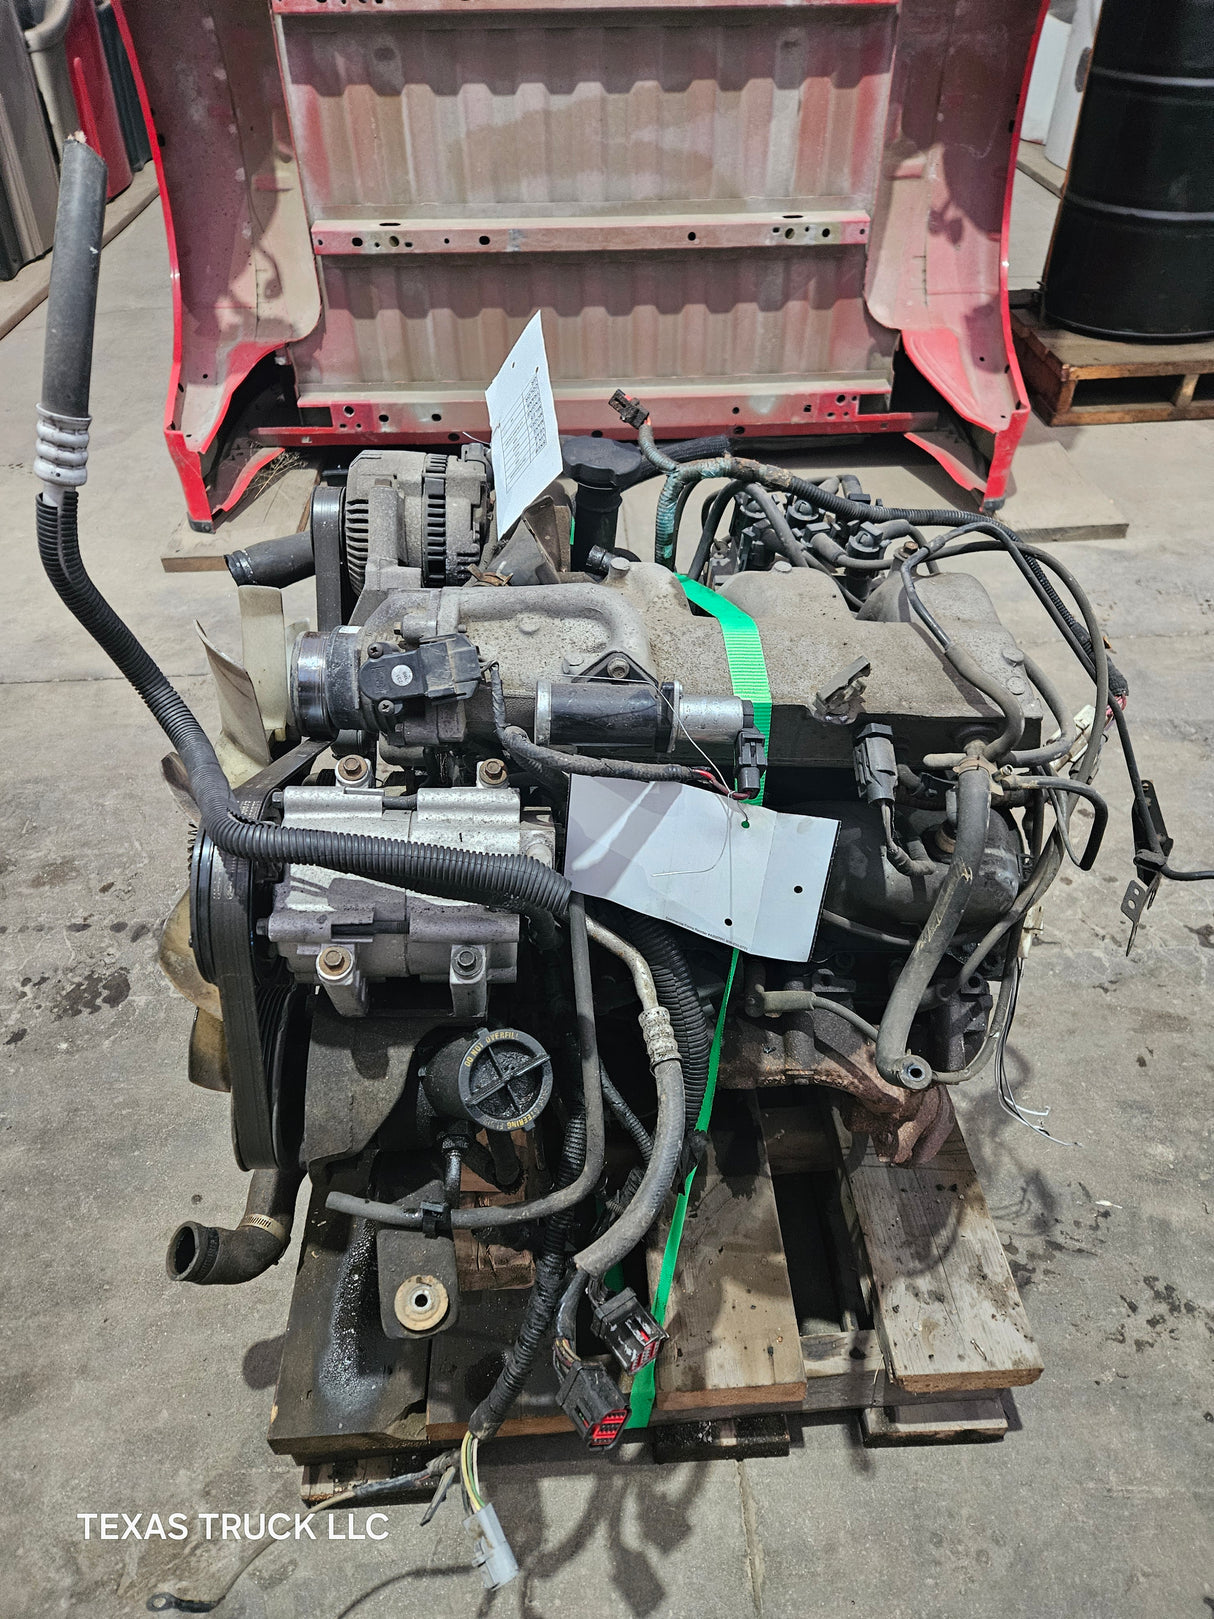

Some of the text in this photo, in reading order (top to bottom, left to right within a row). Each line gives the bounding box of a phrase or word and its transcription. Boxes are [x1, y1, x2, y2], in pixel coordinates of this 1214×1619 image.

[464, 1057, 474, 1067] DO
[471, 1042, 484, 1057] NOT
[506, 1107, 540, 1129] STEERING
